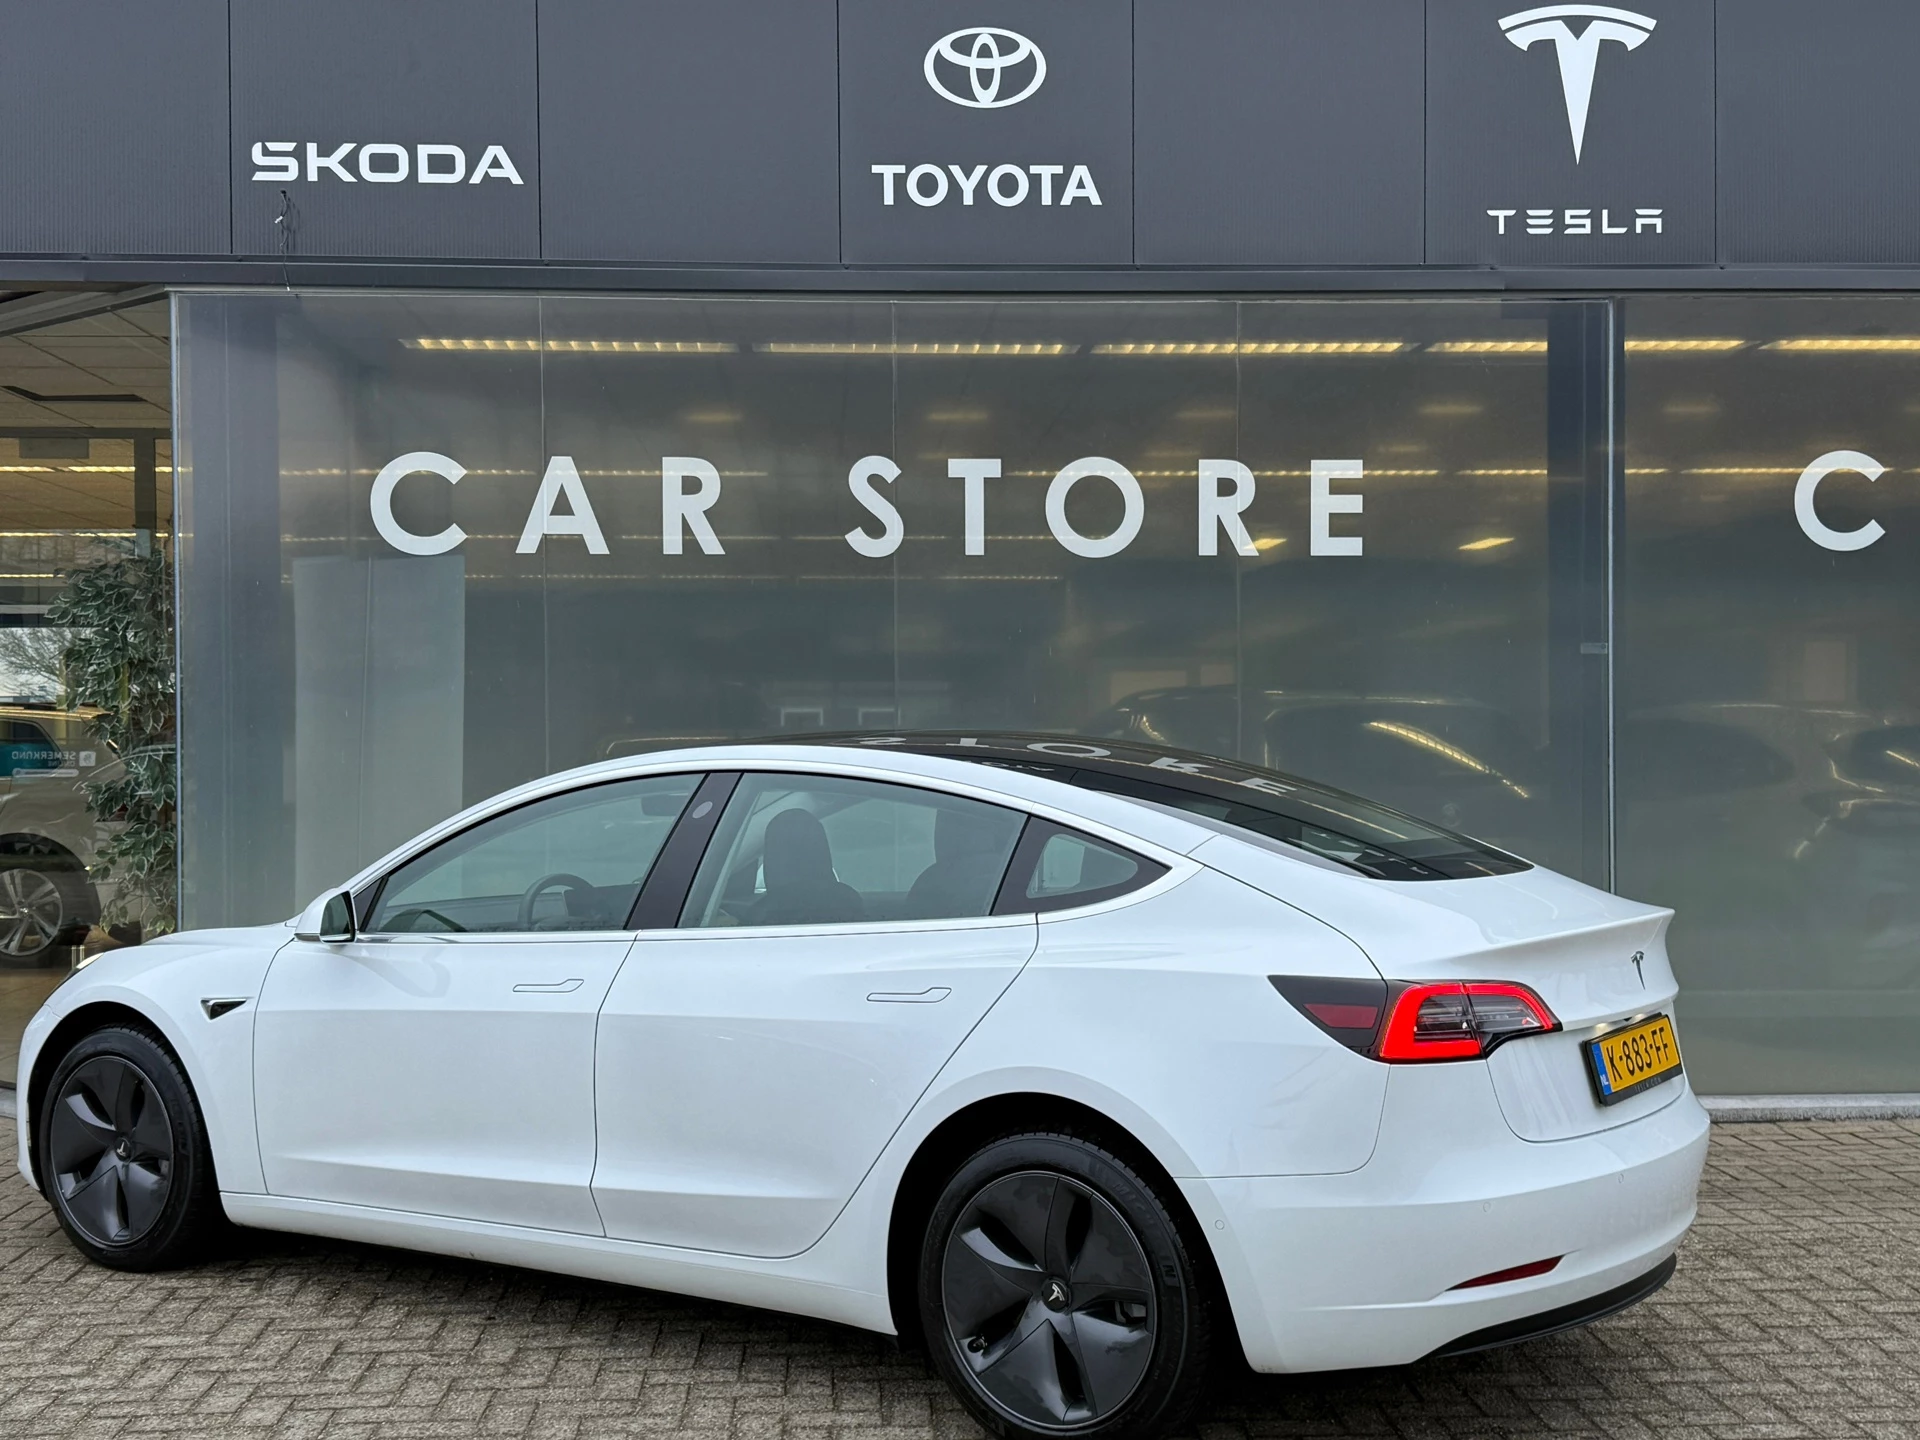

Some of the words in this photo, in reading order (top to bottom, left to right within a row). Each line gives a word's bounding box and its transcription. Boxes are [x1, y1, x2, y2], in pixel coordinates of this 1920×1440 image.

[871, 163, 1103, 207] TOYOTA
[1486, 208, 1664, 235] TESLA
[369, 451, 728, 557] CAR
[846, 456, 1364, 559] STORE
[1793, 449, 1887, 552] C
[1606, 1026, 1669, 1083] K-883-FF
